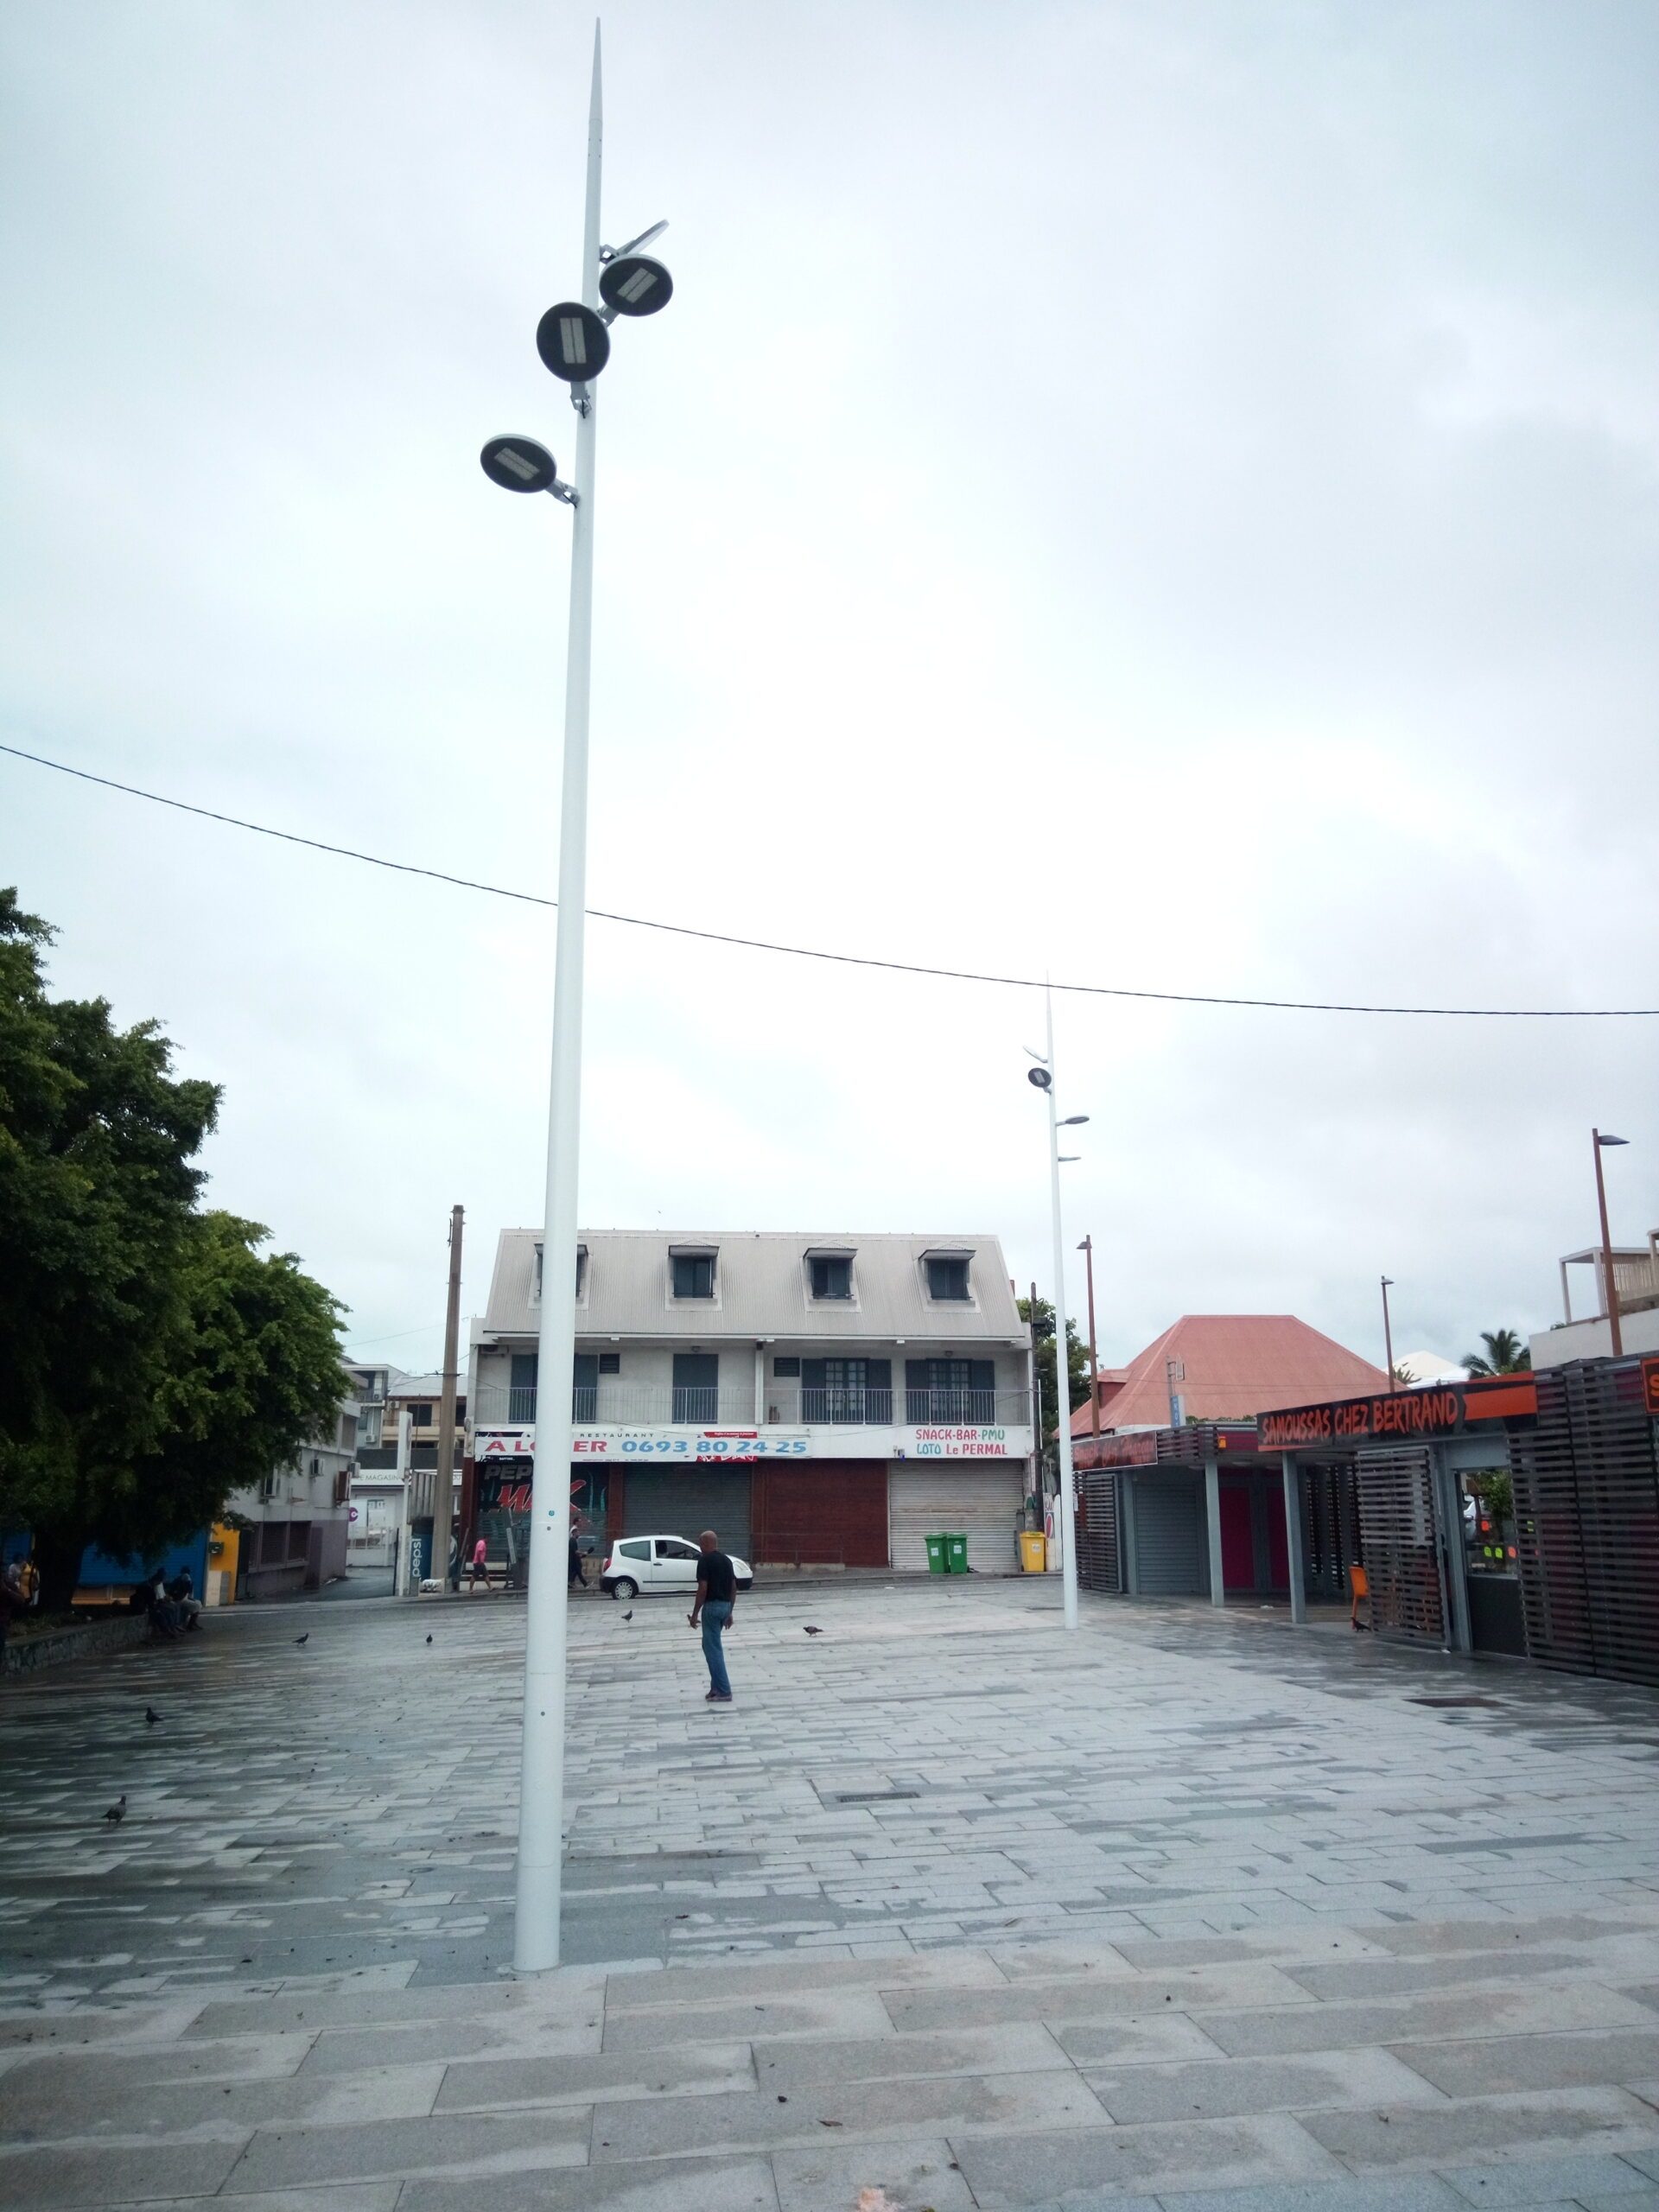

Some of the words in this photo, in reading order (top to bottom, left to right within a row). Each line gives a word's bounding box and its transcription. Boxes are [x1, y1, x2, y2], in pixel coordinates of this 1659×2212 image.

[1263, 1408, 1331, 1444] SAMOUSSAS
[1334, 1404, 1369, 1435] CHEZ
[1373, 1391, 1459, 1434] BERTRAND
[486, 1440, 506, 1452] A
[514, 1440, 607, 1452] LER
[622, 1440, 688, 1453] 0693
[696, 1440, 728, 1453] 80
[736, 1440, 767, 1452] 24
[776, 1441, 807, 1453] 25
[917, 1443, 941, 1454] LOTO
[946, 1444, 958, 1454] Le
[963, 1444, 1007, 1455] PERMAL
[485, 1465, 533, 1479] PEP
[412, 1538, 423, 1578] pepsi
